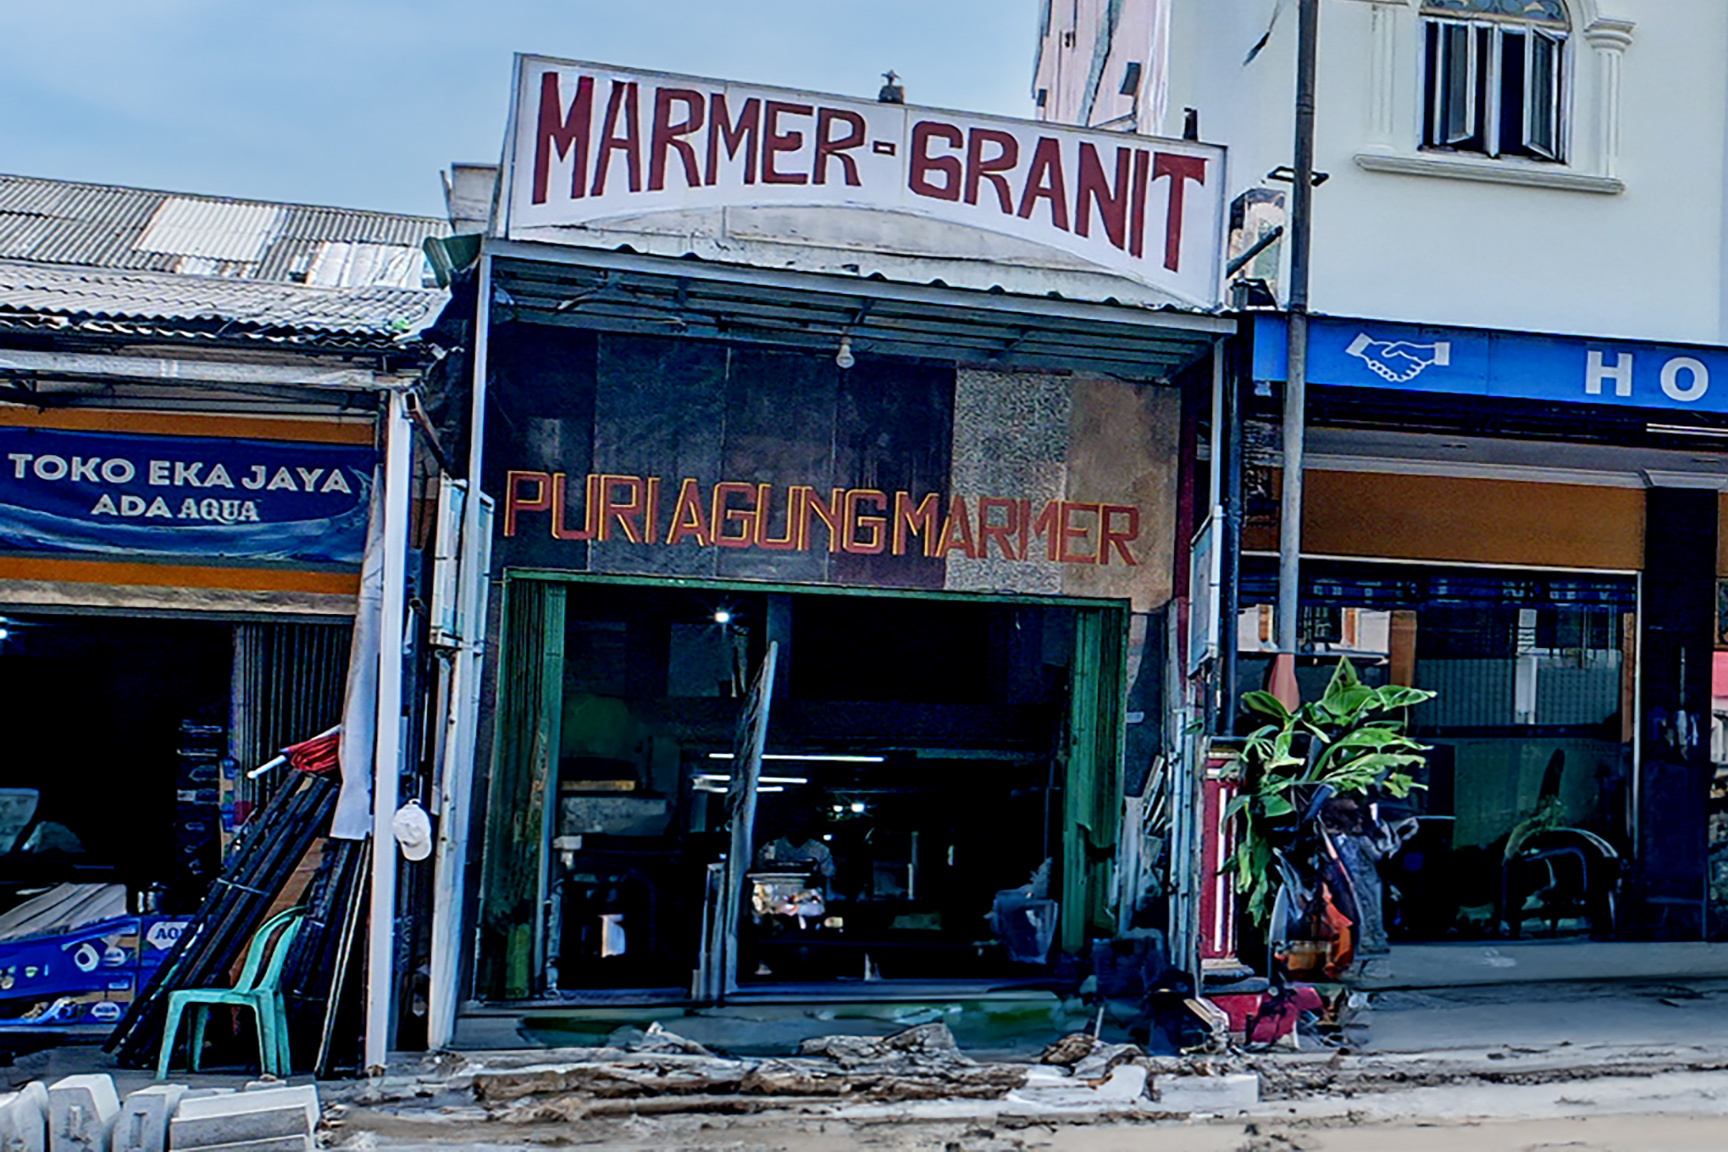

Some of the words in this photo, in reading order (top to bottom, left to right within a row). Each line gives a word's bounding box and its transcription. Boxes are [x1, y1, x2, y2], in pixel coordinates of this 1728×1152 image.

[8, 453, 135, 484] TOKO
[149, 459, 234, 489] EKA
[242, 464, 351, 494] JAYA
[91, 494, 173, 519] ADA
[177, 498, 260, 525] AQUA
